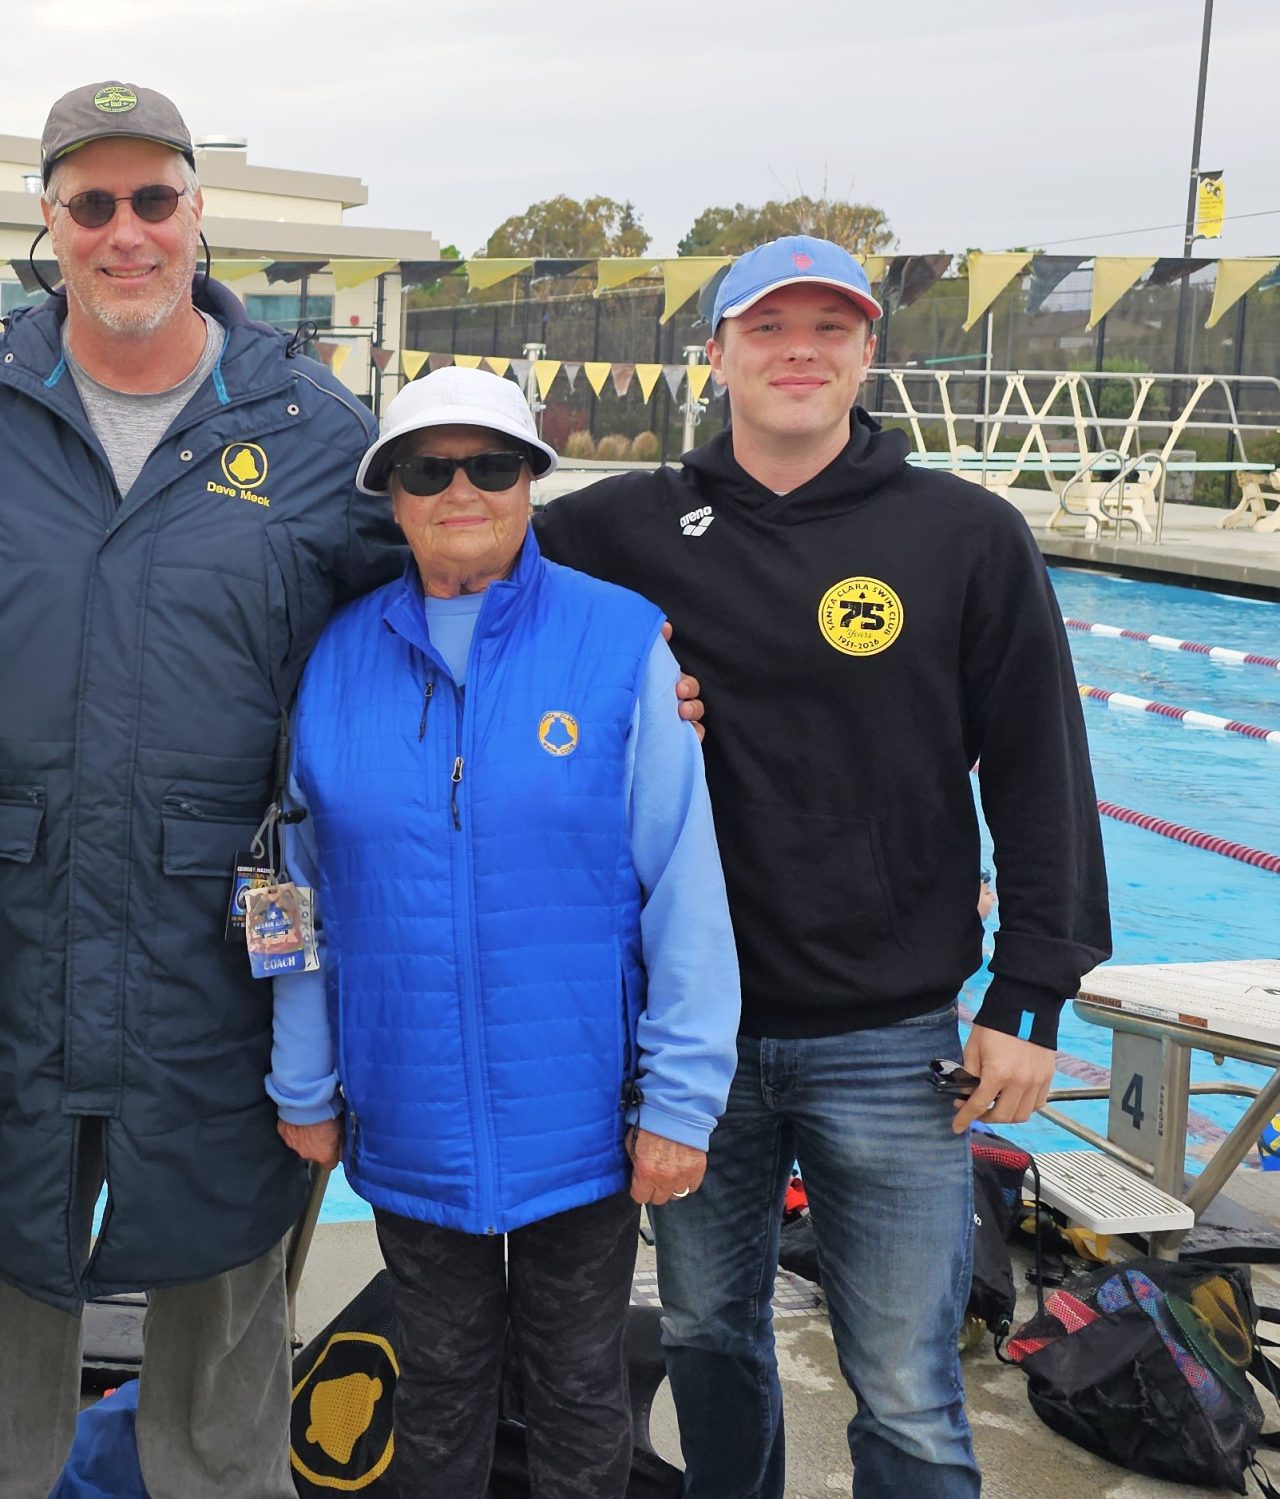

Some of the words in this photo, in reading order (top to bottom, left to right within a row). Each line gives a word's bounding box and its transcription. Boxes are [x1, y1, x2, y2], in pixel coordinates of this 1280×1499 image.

[207, 481, 236, 497] Dave
[240, 489, 271, 507] Meck
[679, 506, 712, 528] arena
[826, 598, 837, 631] SANTA
[837, 583, 869, 597] CLARA
[872, 587, 894, 608] SWIM
[884, 612, 896, 636] CLUB
[839, 600, 885, 631] 75
[837, 635, 880, 649] 1951-2026
[847, 629, 873, 639] Years
[263, 956, 296, 970] COACH
[1121, 1072, 1144, 1130] 4
